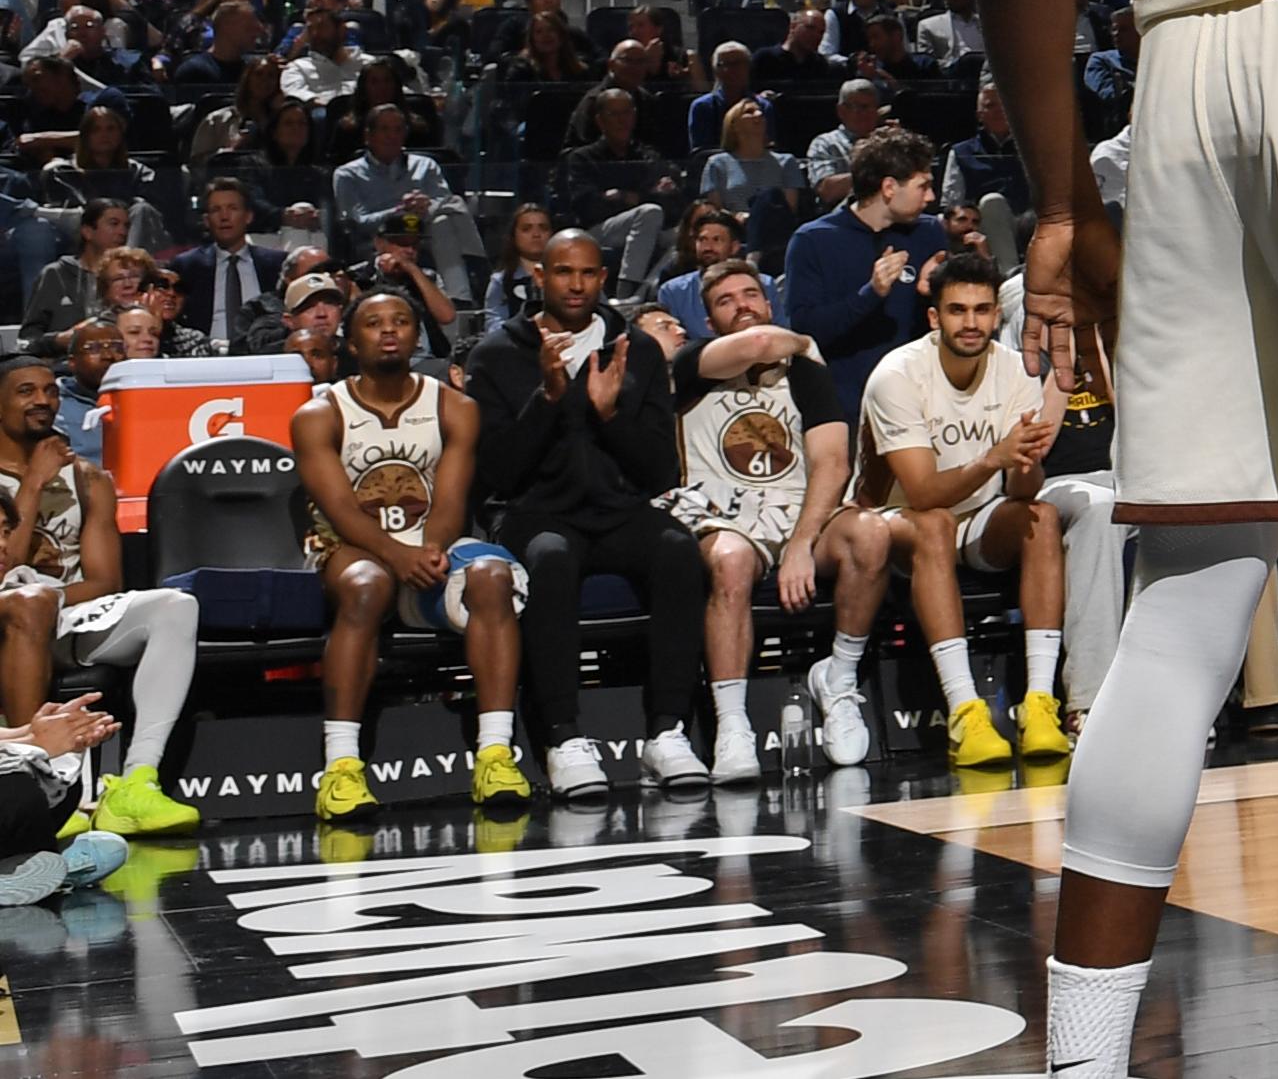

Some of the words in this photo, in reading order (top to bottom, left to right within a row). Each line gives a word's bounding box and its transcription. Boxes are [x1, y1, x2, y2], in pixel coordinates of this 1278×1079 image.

[714, 388, 797, 427] TOWN
[183, 456, 296, 475] WAYMO
[748, 451, 772, 476] 61
[379, 505, 406, 531] 18
